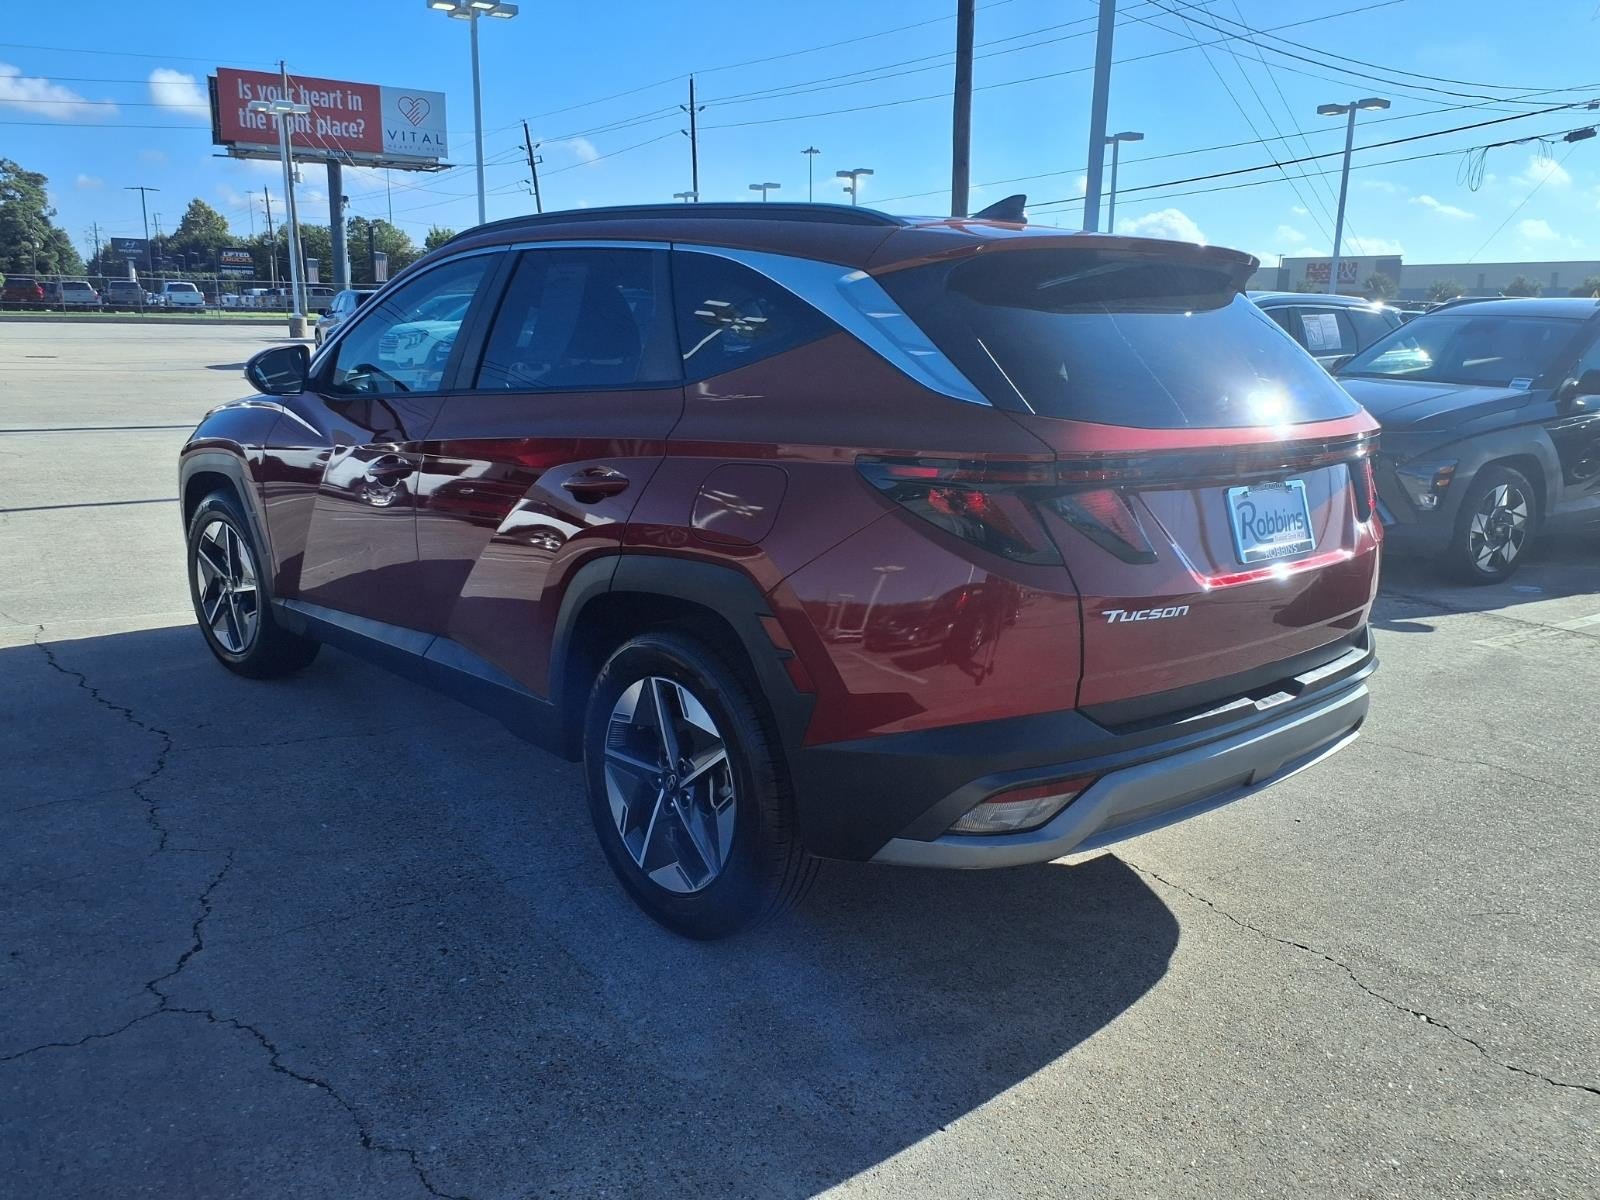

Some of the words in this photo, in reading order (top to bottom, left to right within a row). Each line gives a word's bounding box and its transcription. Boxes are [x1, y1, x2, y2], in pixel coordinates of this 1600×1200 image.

[238, 78, 252, 100] Is
[300, 85, 343, 110] heart
[347, 90, 363, 111] in
[239, 107, 267, 129] the
[271, 112, 313, 135] rght
[316, 116, 365, 138] place?
[387, 129, 444, 146] VITAL
[1236, 501, 1304, 544] Robbins
